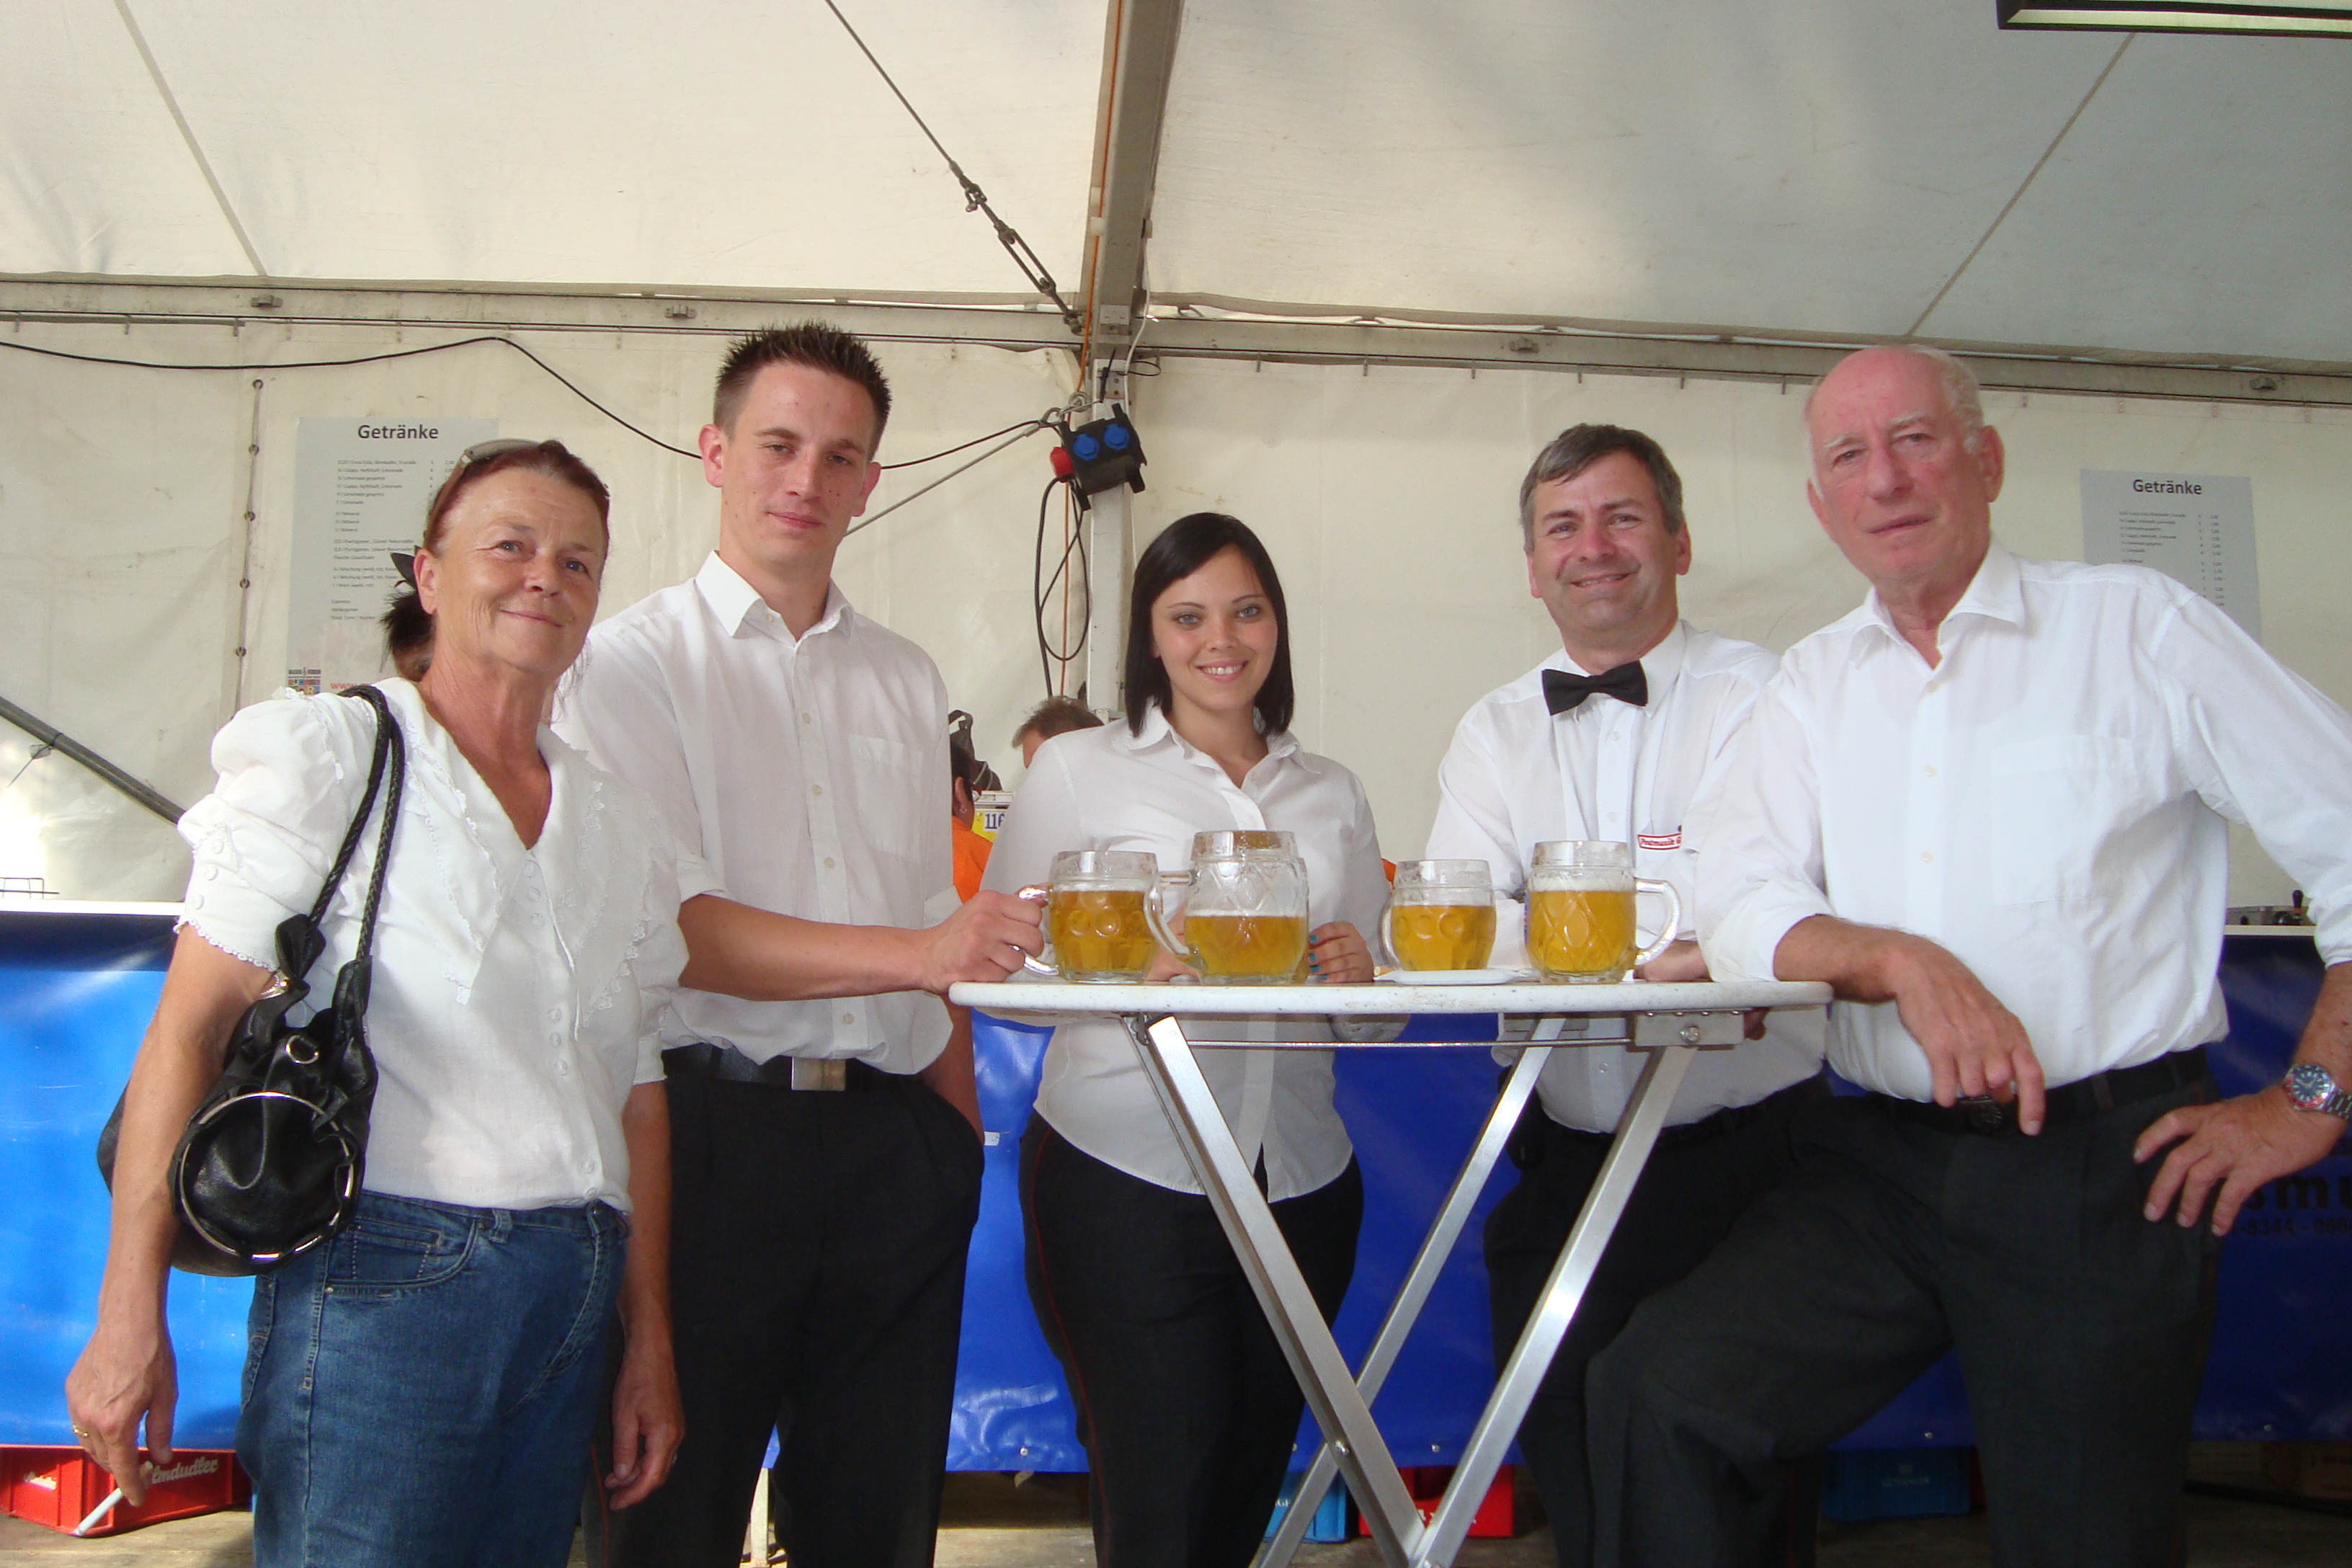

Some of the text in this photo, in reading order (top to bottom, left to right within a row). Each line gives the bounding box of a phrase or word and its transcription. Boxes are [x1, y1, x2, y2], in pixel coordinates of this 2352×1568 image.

[358, 424, 439, 440] Getränke
[2132, 478, 2202, 495] Getränke
[152, 1457, 218, 1484] lmdudler
